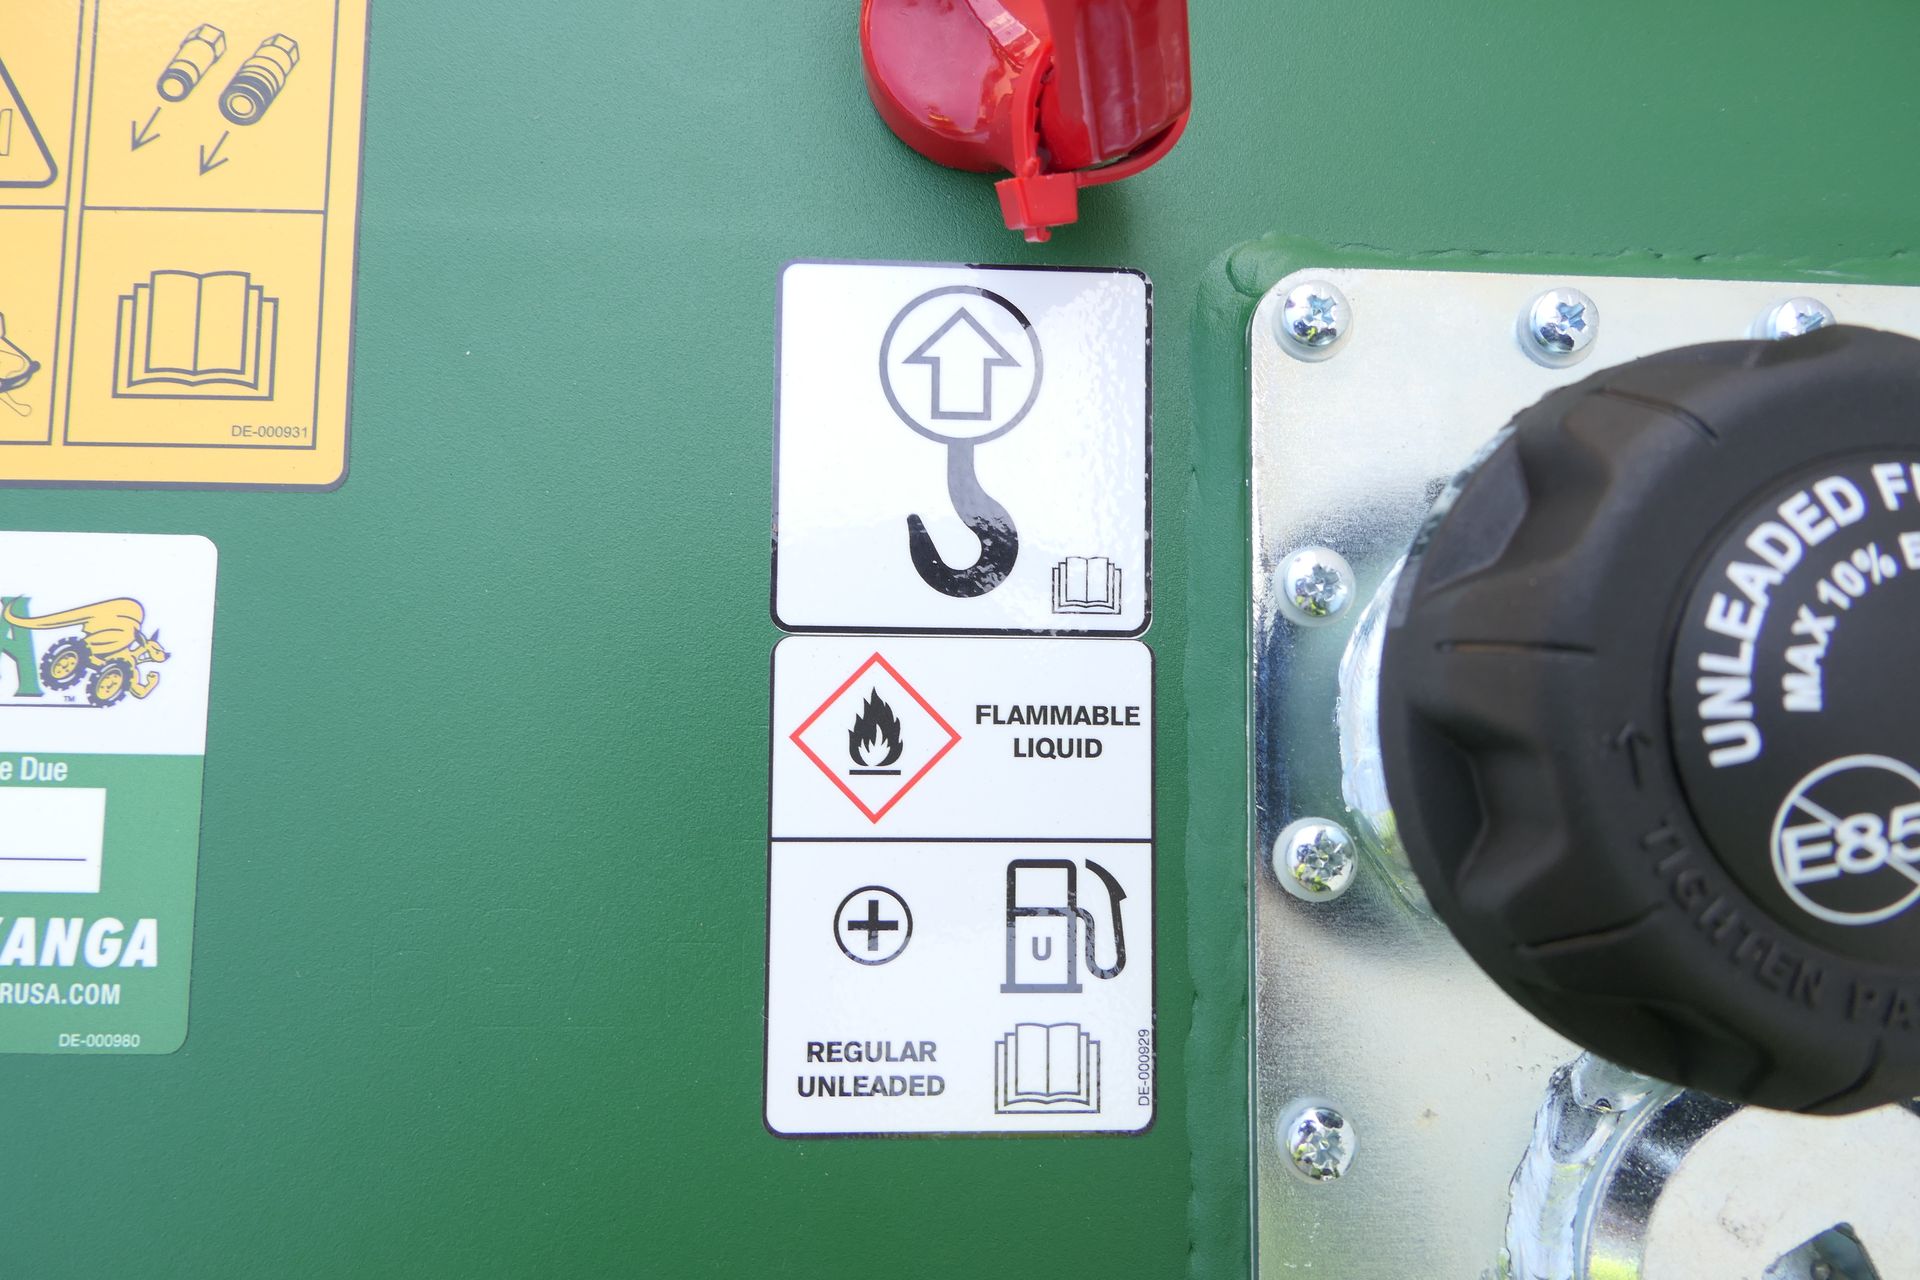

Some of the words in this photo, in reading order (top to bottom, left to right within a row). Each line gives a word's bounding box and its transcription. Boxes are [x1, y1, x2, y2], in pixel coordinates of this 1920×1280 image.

[231, 425, 308, 438] DE-000931
[1697, 475, 1866, 768] UNLEADED
[1871, 462, 1920, 511] F
[1782, 603, 1837, 712] MAX
[1816, 541, 1898, 610] 10%
[976, 704, 1140, 726] FLAMMABLE
[1013, 737, 1102, 759] LIQUID
[21, 756, 68, 781] Due
[0, 917, 157, 967] ANGA
[1032, 937, 1051, 961] U
[58, 1033, 140, 1047] DE-000980
[807, 1041, 937, 1063] REGULAR
[1138, 1029, 1150, 1106] DE-000929
[797, 1076, 945, 1098] UNLEADED
